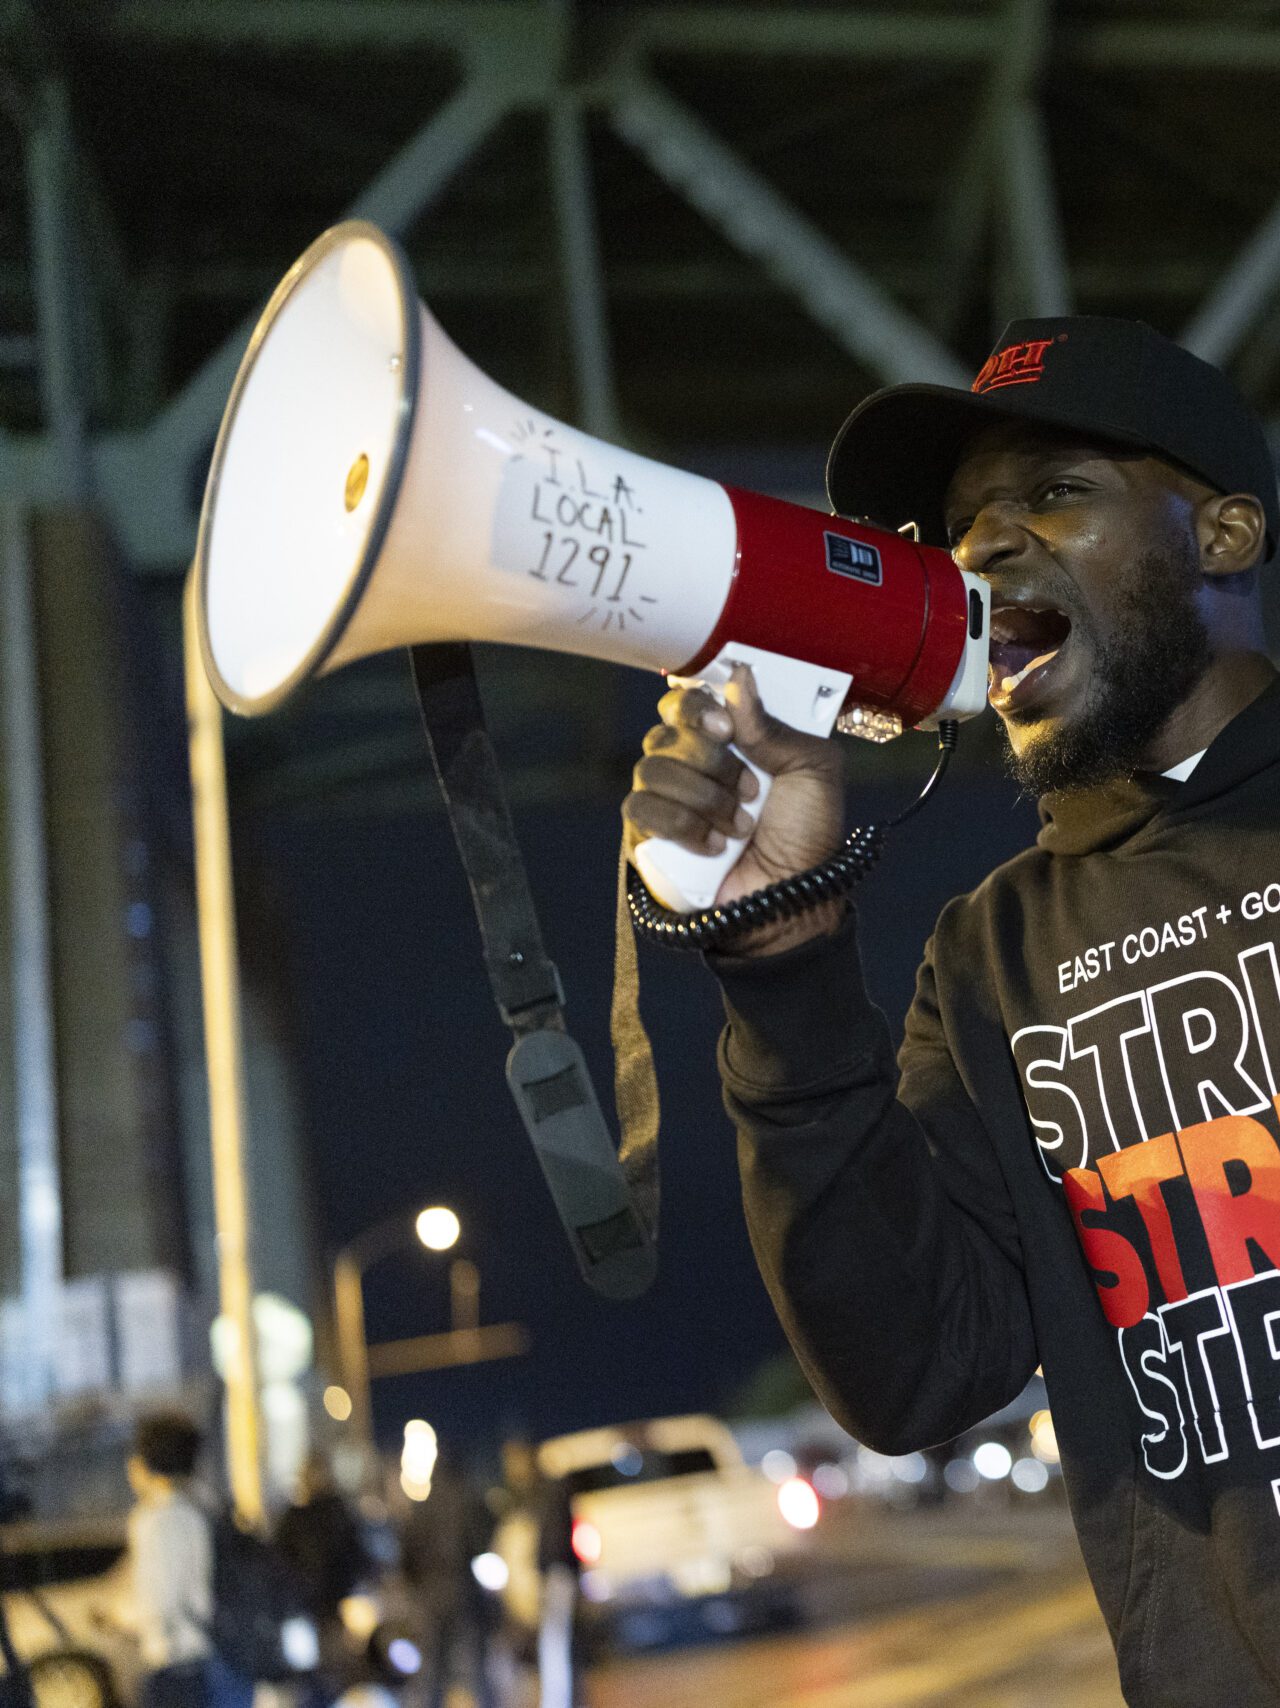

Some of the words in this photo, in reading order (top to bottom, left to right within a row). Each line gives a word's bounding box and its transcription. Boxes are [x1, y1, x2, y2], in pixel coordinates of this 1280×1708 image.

[532, 483, 646, 549] LOCAL
[528, 531, 632, 602] 1291
[1057, 942, 1116, 994] EAST
[1122, 907, 1208, 965] COAST
[1216, 905, 1232, 925] +
